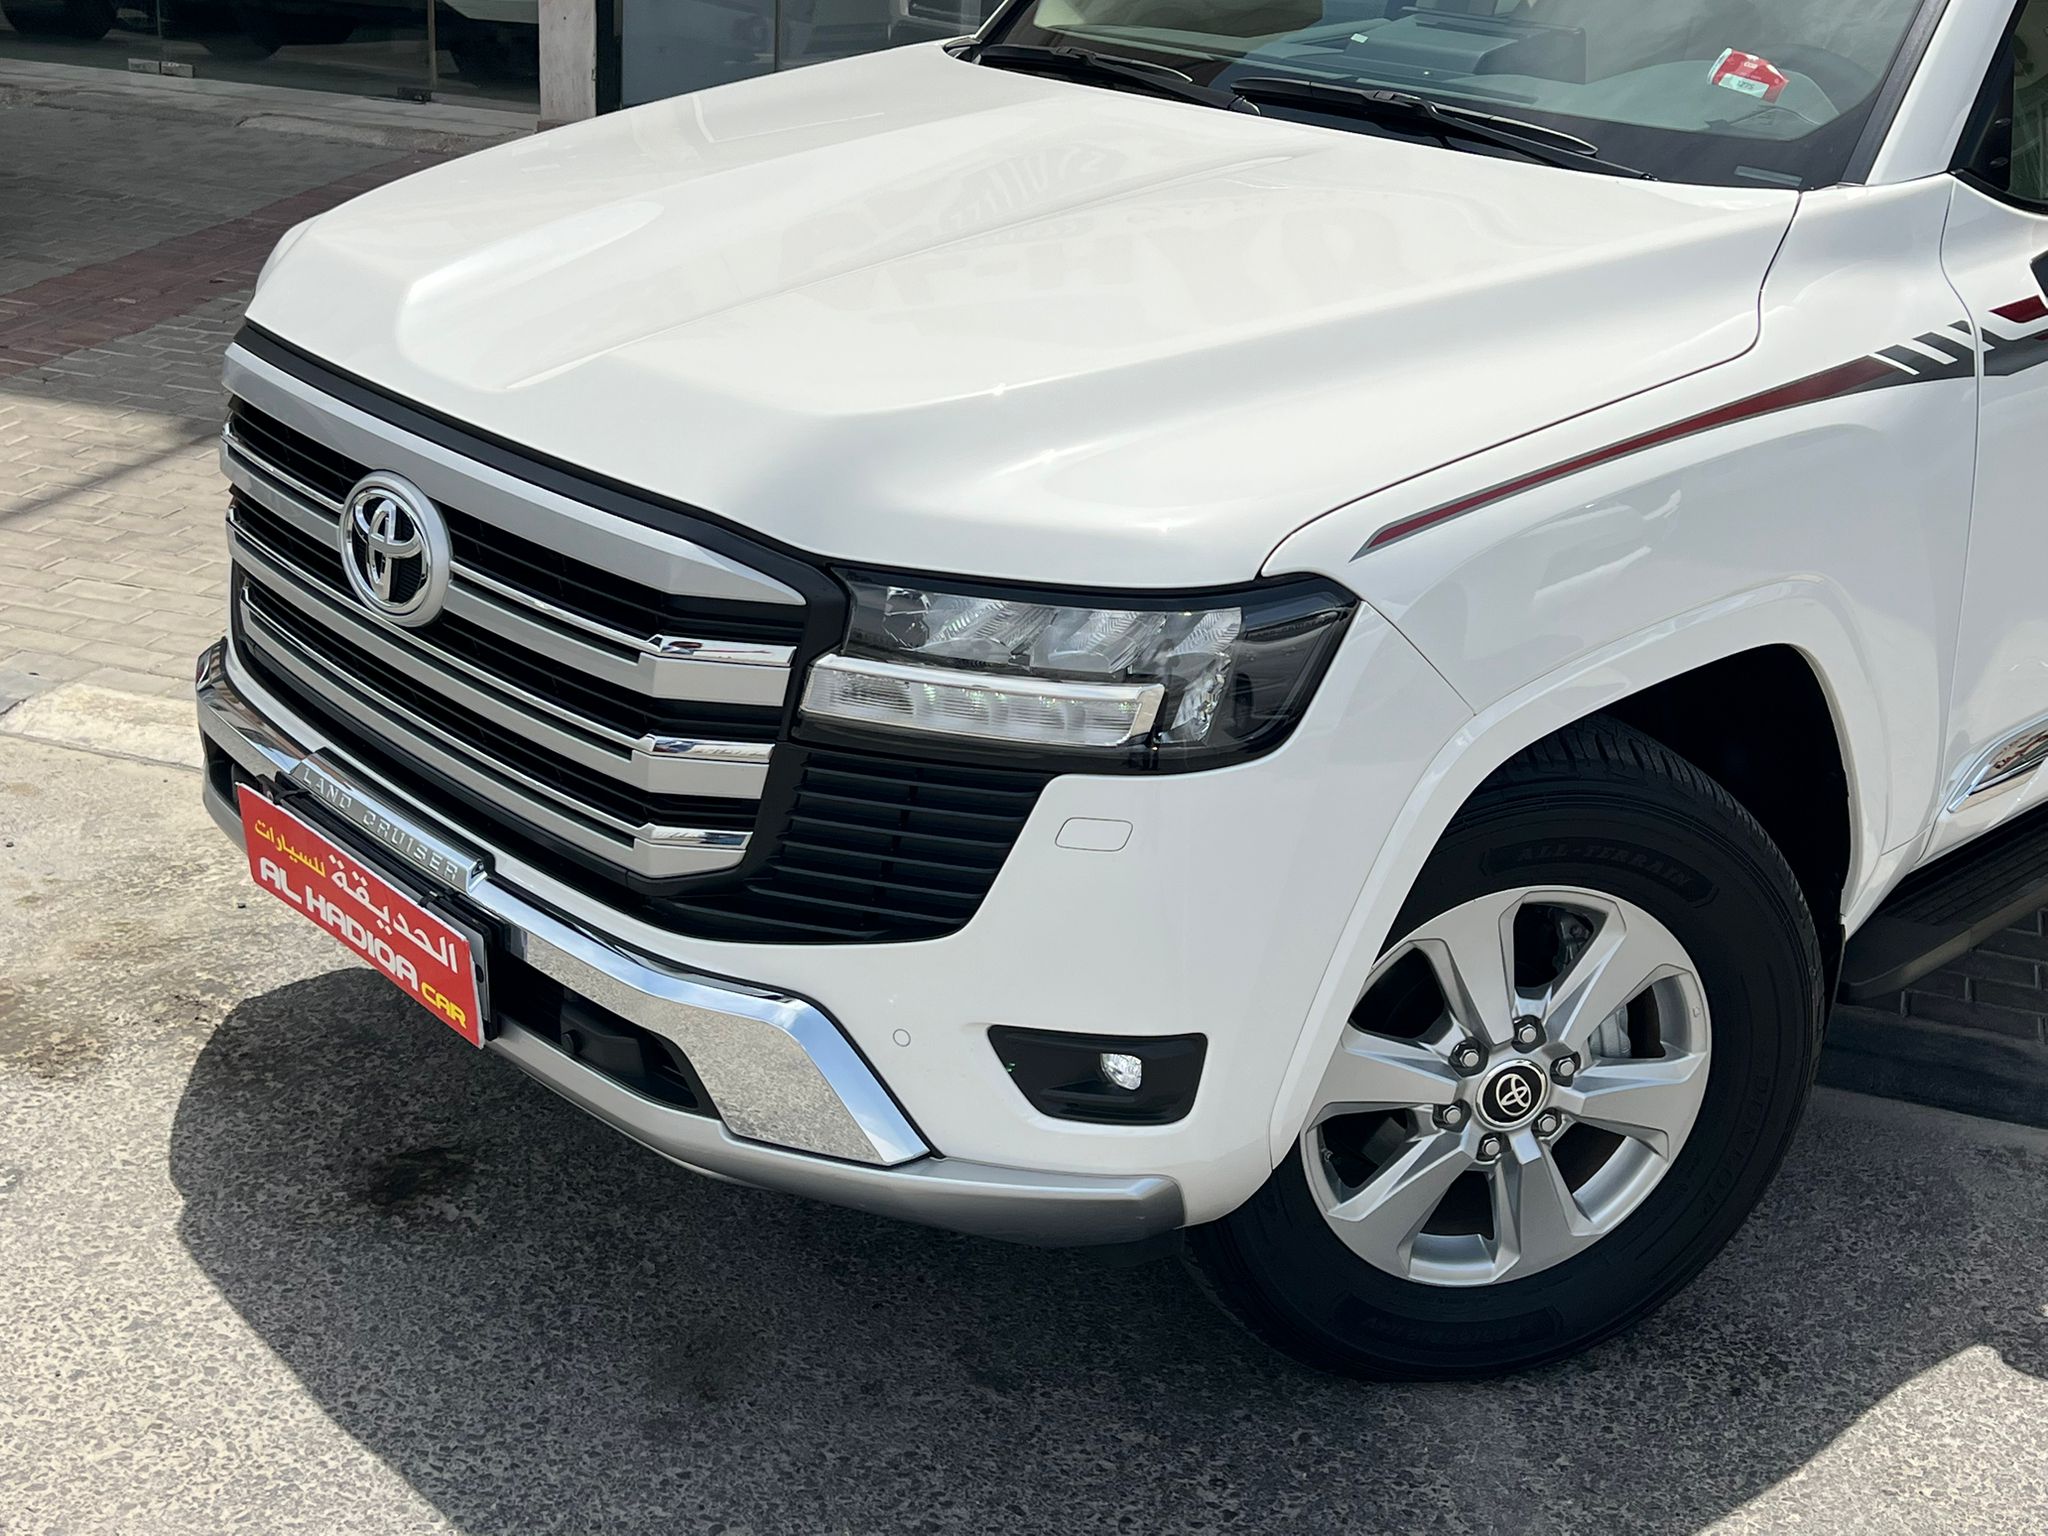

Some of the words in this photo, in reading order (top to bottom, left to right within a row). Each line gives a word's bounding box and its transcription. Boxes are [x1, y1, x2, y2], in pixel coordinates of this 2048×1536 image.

[254, 819, 326, 878] للسيارات
[303, 767, 352, 809] LAND
[362, 810, 458, 882] CRUISER
[260, 857, 302, 905] AL
[305, 886, 419, 991] HADIQA
[421, 981, 468, 1029] CAR
[329, 853, 458, 974] الحديقة
